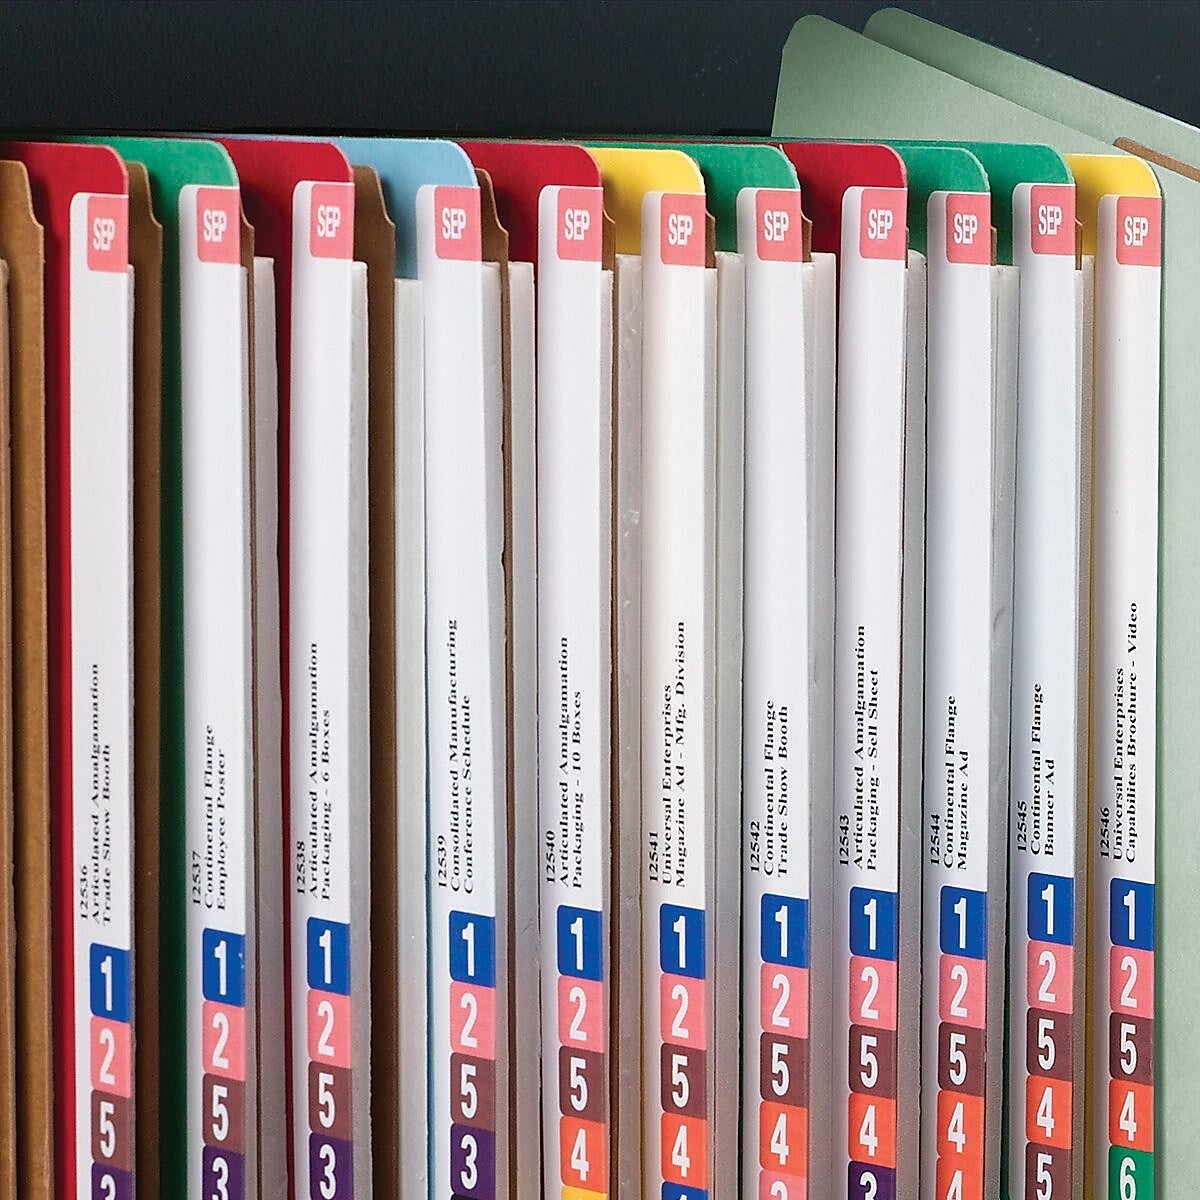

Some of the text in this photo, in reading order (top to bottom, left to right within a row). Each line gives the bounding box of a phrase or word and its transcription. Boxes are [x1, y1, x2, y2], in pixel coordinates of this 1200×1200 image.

[93, 218, 115, 250] SEP
[203, 210, 227, 242] SEP
[442, 208, 466, 240] SEP
[668, 213, 693, 246] SEP
[868, 209, 893, 240] SEP
[1123, 216, 1149, 247] SEP
[1128, 603, 1137, 653] Video
[675, 622, 685, 695] Division
[675, 704, 686, 745] Mfg.
[1127, 673, 1136, 756] Brochure
[102, 745, 110, 800] Booth
[447, 620, 460, 891] Consolidated Manufacturing
[676, 766, 685, 791] Ad
[943, 696, 957, 868] Continental Flange
[1031, 684, 1043, 855] Continental Flange
[1113, 668, 1125, 859] Universal Enterprises
[91, 664, 100, 922] Articulated Amalgamation
[461, 696, 473, 894] Conference Schedule
[662, 685, 673, 884] Universal Enterprises
[764, 701, 776, 875] Continental Flange
[778, 707, 787, 877] Trade Show Booth
[958, 751, 969, 870] Magazine Ad
[1045, 760, 1054, 855] Banner Ad
[205, 726, 214, 909] Continental Flange
[217, 750, 227, 910] Employee Poster
[676, 799, 687, 887] Magazine
[931, 814, 941, 866] 12544
[1017, 800, 1028, 852] 12545
[1100, 807, 1109, 859] 12546
[437, 835, 447, 887] 12539
[649, 832, 658, 882] 12541
[750, 821, 760, 872] 12542
[80, 866, 88, 918] 12536
[192, 851, 201, 904] 12537
